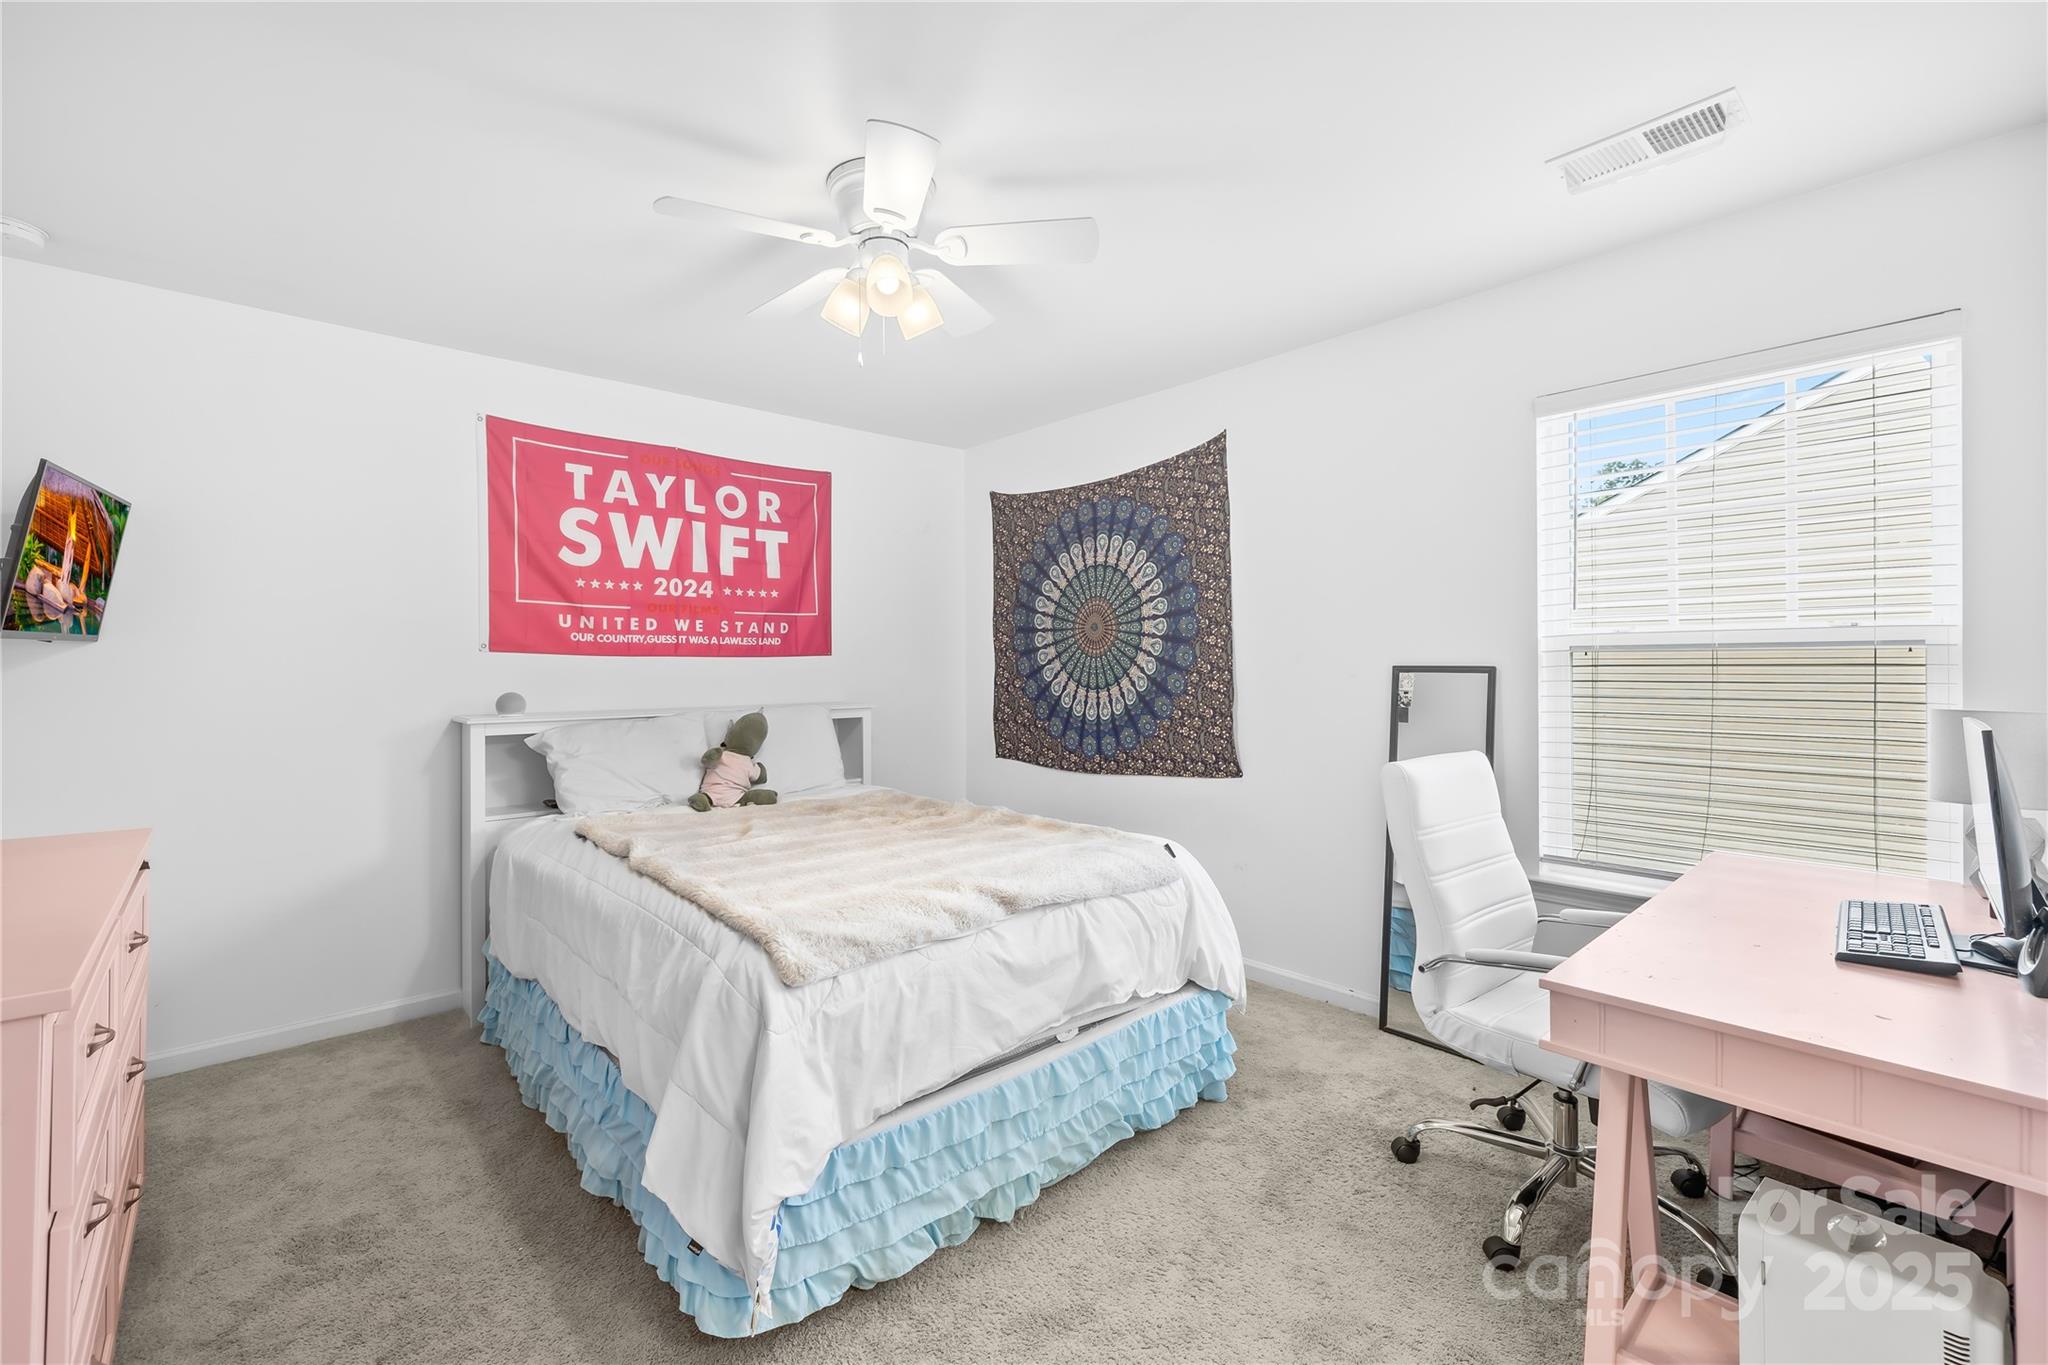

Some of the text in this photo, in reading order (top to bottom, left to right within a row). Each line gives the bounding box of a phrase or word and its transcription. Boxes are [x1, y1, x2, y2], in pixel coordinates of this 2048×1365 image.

[564, 462, 782, 524] TAYLOR
[558, 507, 789, 579] SWIFT
[654, 577, 714, 598] 2024
[647, 602, 675, 613] OUR
[558, 613, 789, 634] UNITED WE STAND
[570, 632, 595, 642] OUR
[678, 635, 688, 645] IT
[688, 635, 710, 645] WAS
[710, 636, 719, 645] A
[719, 637, 757, 646] LAWLESS
[758, 637, 782, 646] LAND
